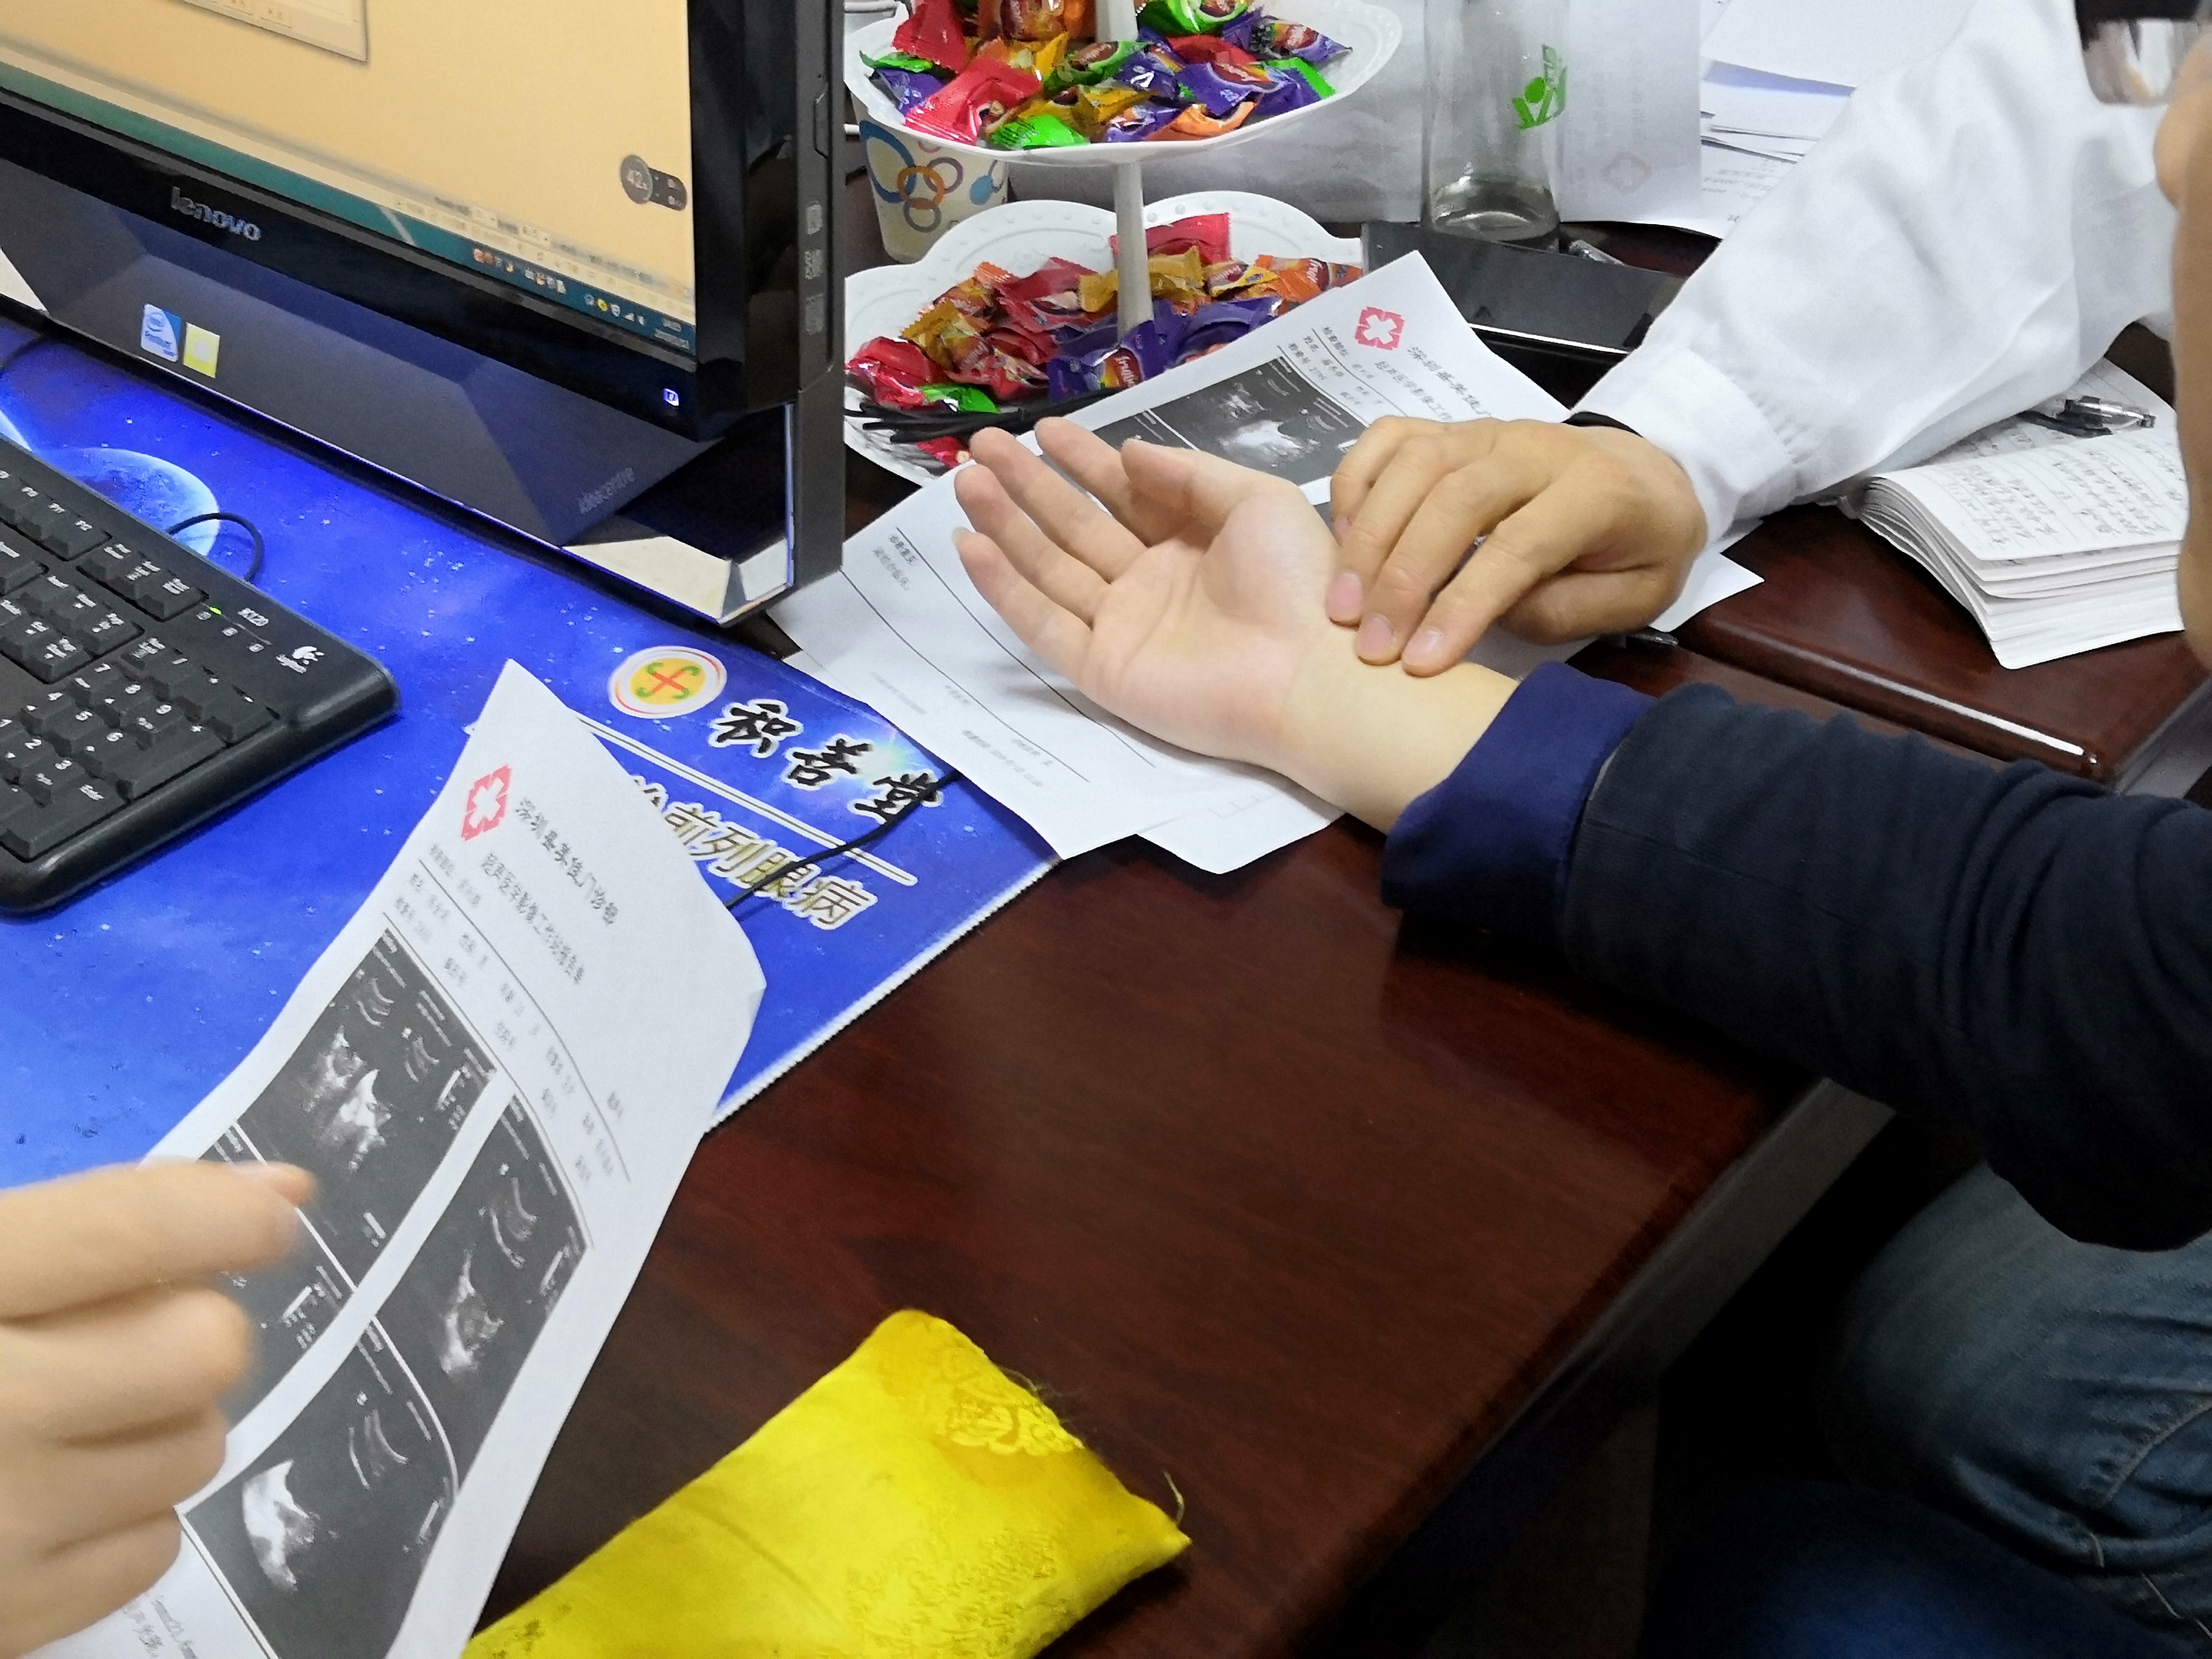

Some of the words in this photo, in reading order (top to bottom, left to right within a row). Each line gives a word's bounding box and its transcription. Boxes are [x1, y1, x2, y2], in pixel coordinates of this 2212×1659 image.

[24, 739, 42, 749] 2
[55, 757, 72, 770] 3
[75, 710, 93, 721] 5
[106, 732, 123, 742] 6
[715, 702, 943, 824] 积善堂
[633, 778, 870, 927] 前列眼病
